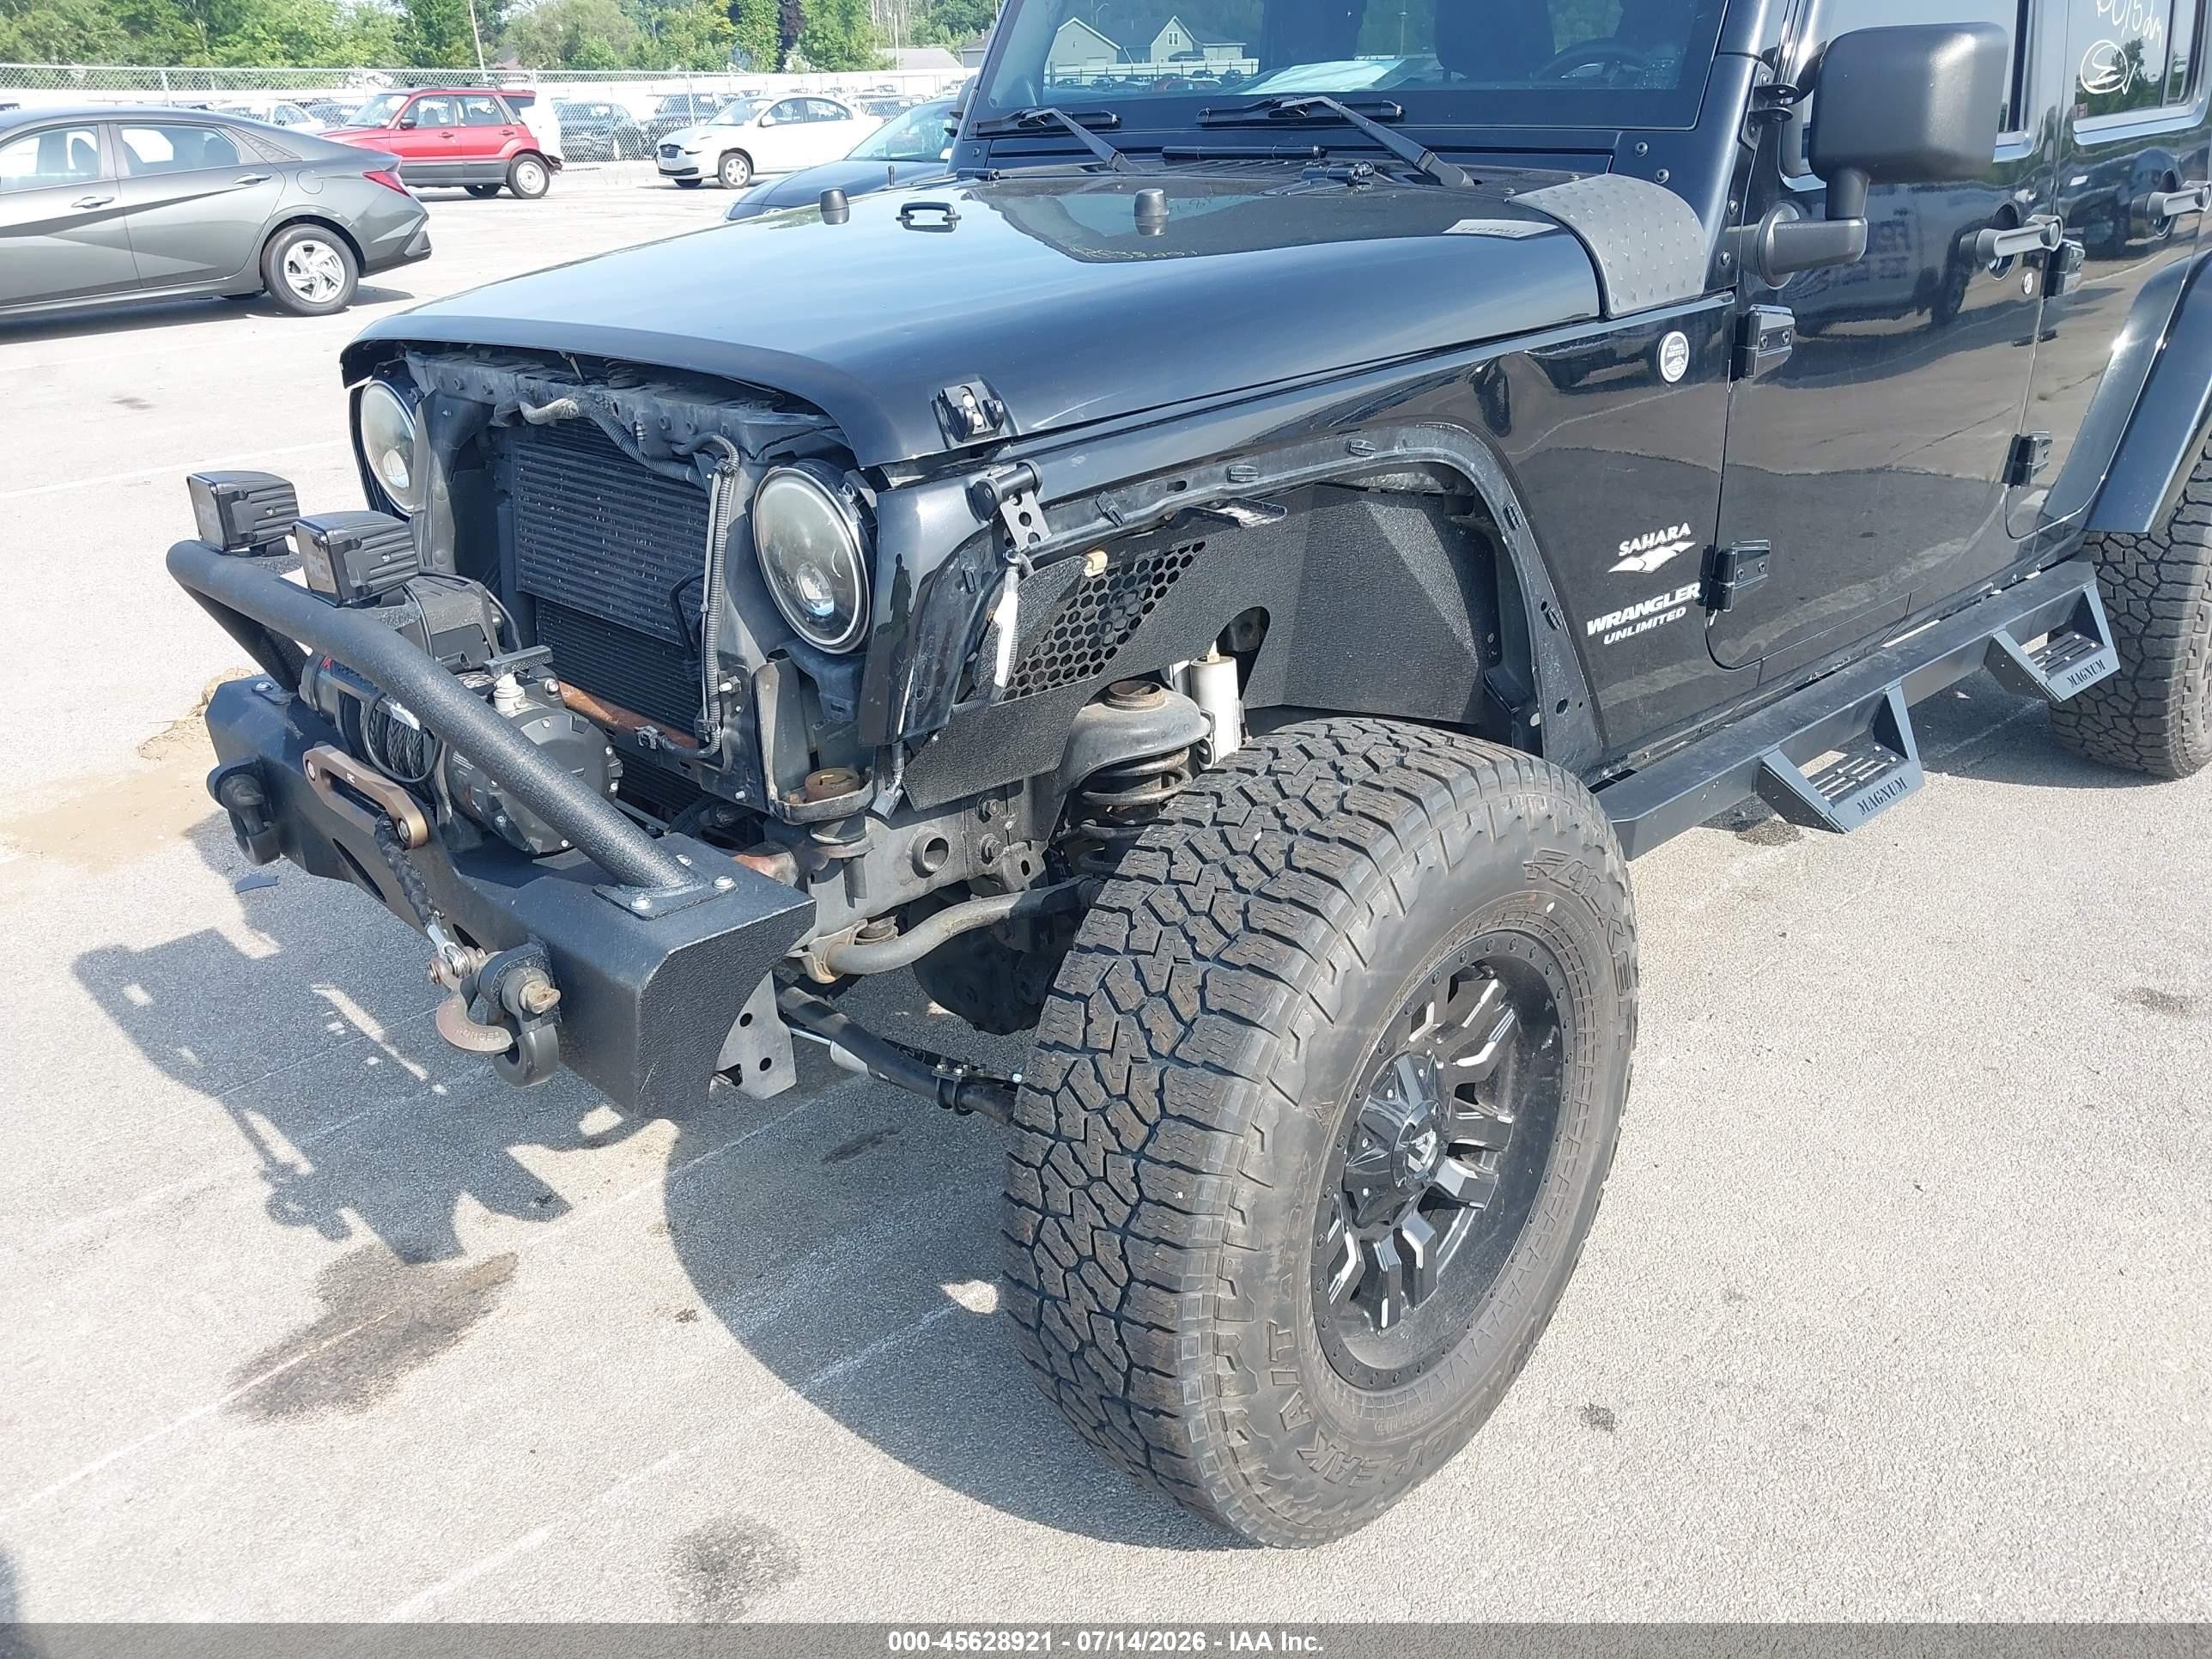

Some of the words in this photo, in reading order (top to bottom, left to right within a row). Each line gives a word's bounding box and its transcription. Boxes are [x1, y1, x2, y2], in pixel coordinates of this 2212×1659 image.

[1618, 522, 1692, 556] SAHARA
[1586, 582, 1702, 637] WRANGLER
[1603, 606, 1687, 645] UNLIMITED
[2066, 659, 2106, 689] MAGNUM
[1856, 776, 1909, 816] MAGNUM
